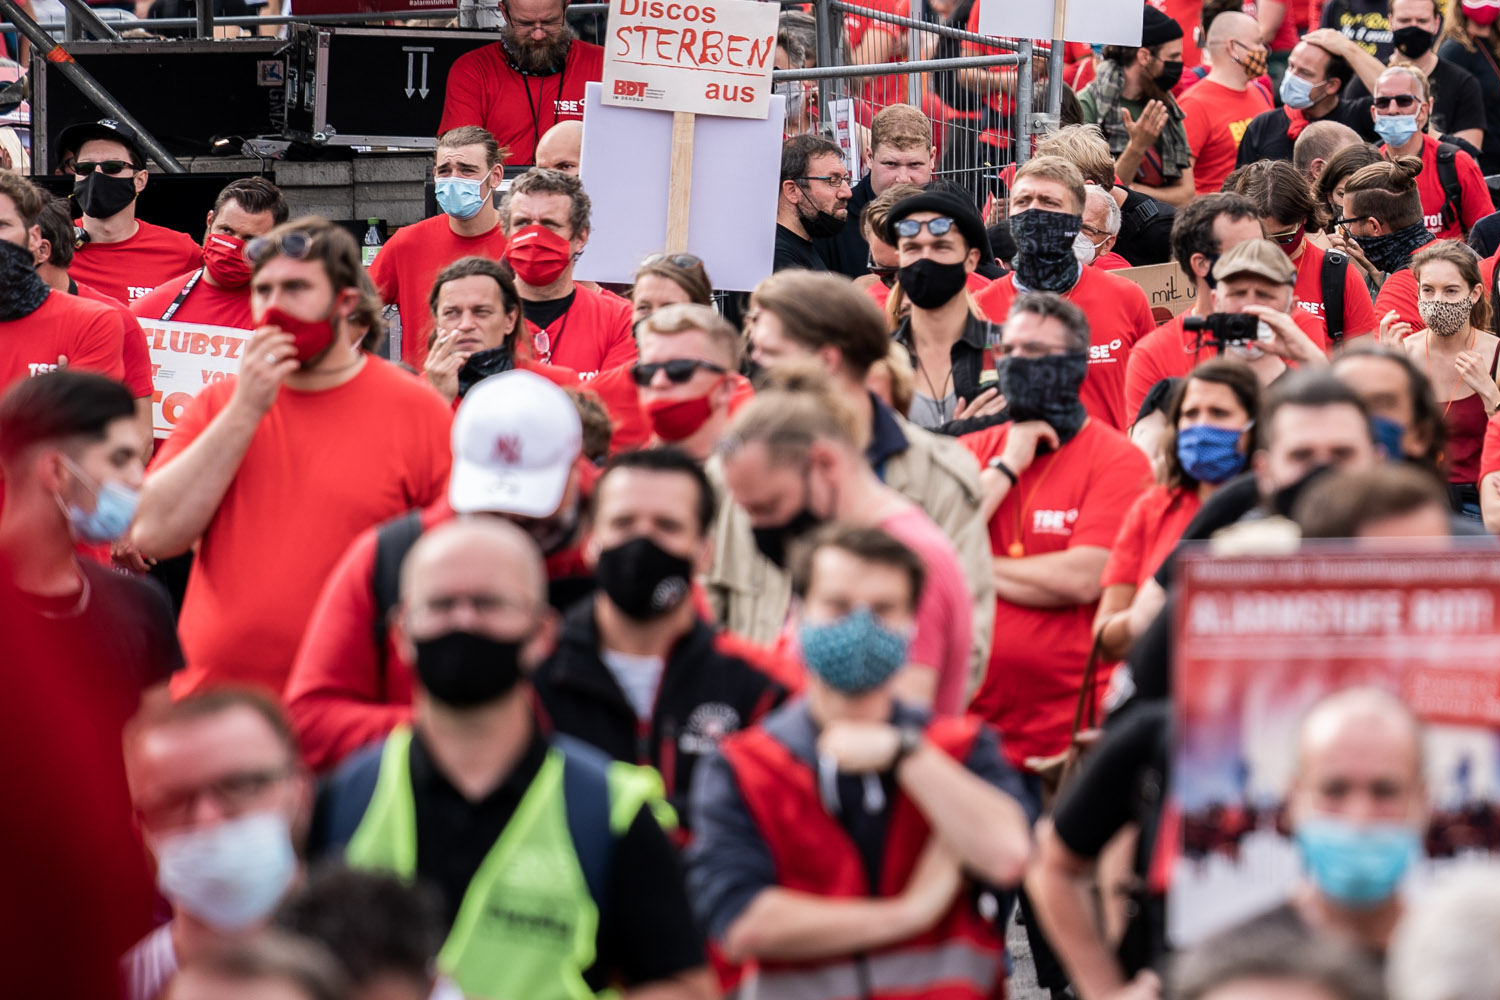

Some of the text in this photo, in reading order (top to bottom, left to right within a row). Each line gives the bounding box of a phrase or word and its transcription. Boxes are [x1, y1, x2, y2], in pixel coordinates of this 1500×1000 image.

[616, 25, 775, 69] STERBEN
[613, 79, 649, 98] BDT
[704, 82, 756, 103] aus
[1152, 276, 1182, 304] mit
[1088, 345, 1110, 359] SE
[1033, 509, 1065, 529] TSE
